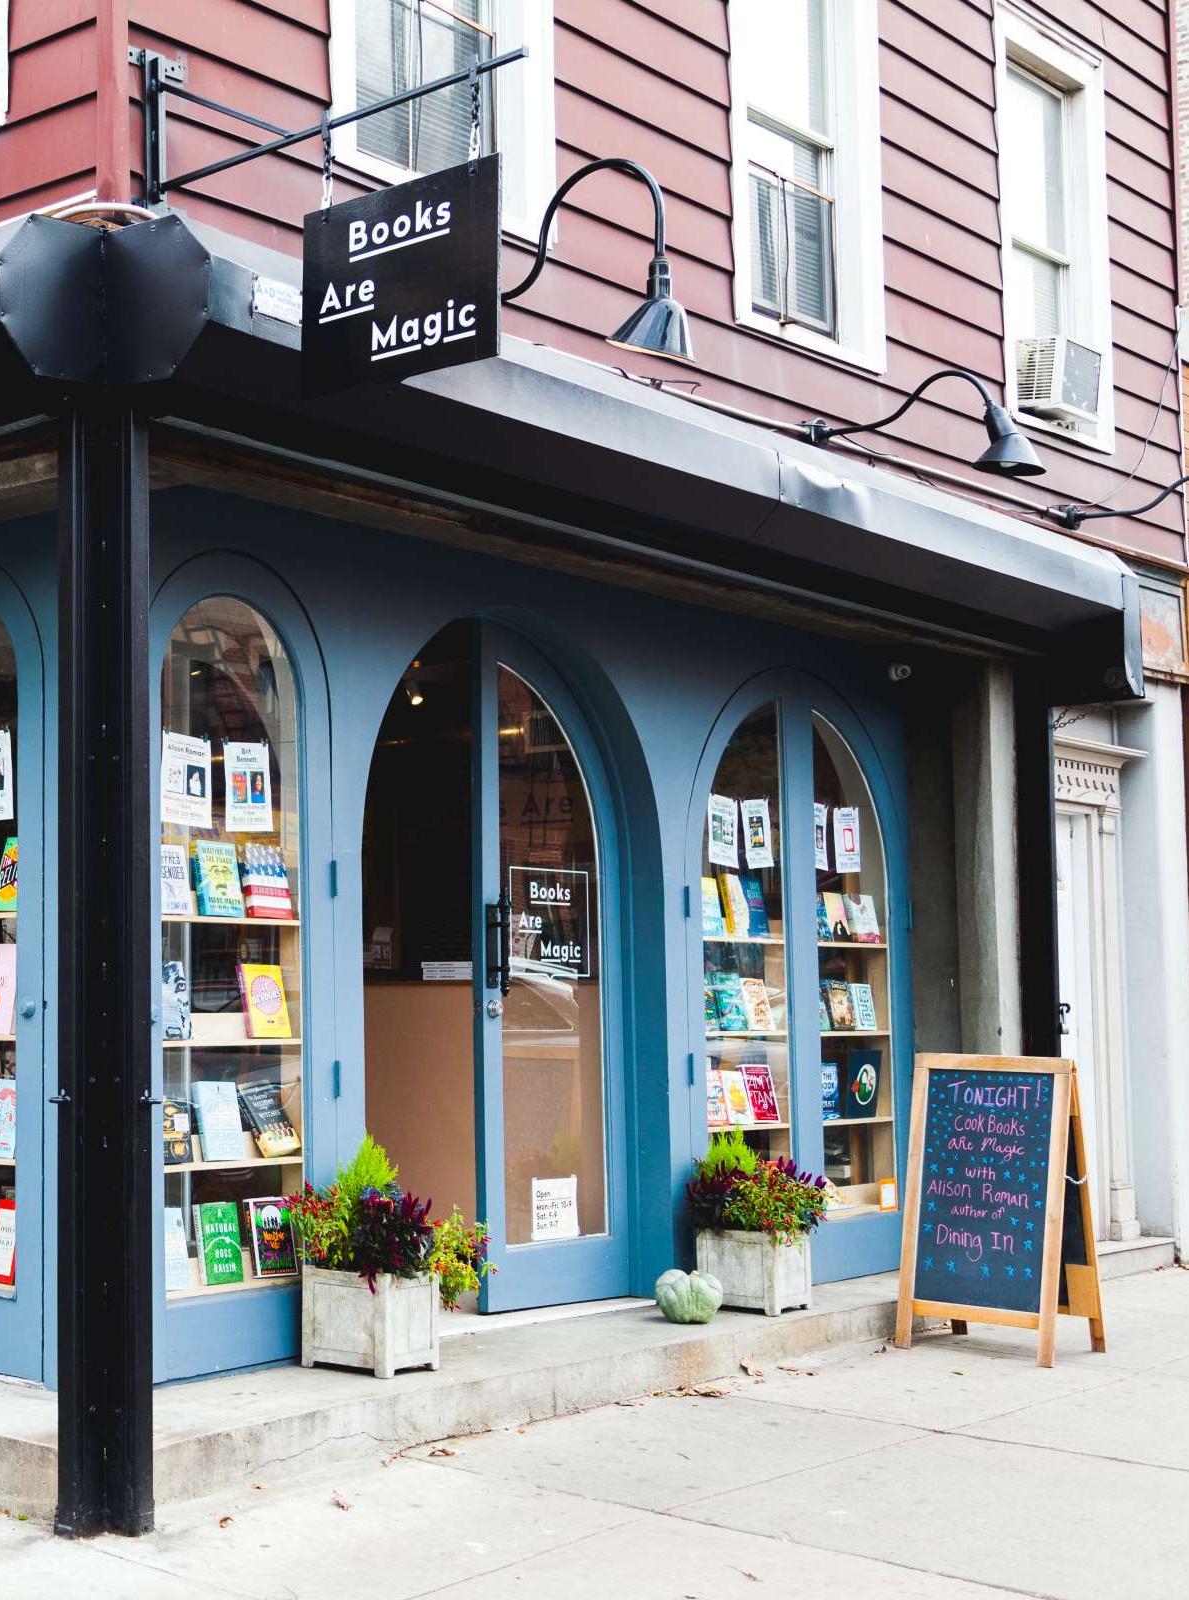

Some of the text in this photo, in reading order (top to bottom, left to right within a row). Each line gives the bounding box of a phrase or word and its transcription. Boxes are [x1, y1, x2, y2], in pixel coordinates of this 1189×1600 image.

[349, 201, 451, 253] Books
[319, 279, 375, 315] Are
[372, 299, 476, 351] Magic
[530, 881, 571, 901] Books
[518, 911, 542, 929] Are
[540, 939, 581, 962] Magic
[981, 1136, 1025, 1161] Magic
[965, 1166, 996, 1181] with
[926, 1179, 1029, 1210] Alison Roman
[951, 1204, 1005, 1220] author of
[205, 1222, 237, 1233] NATURAL
[936, 1223, 1014, 1262] Dining In
